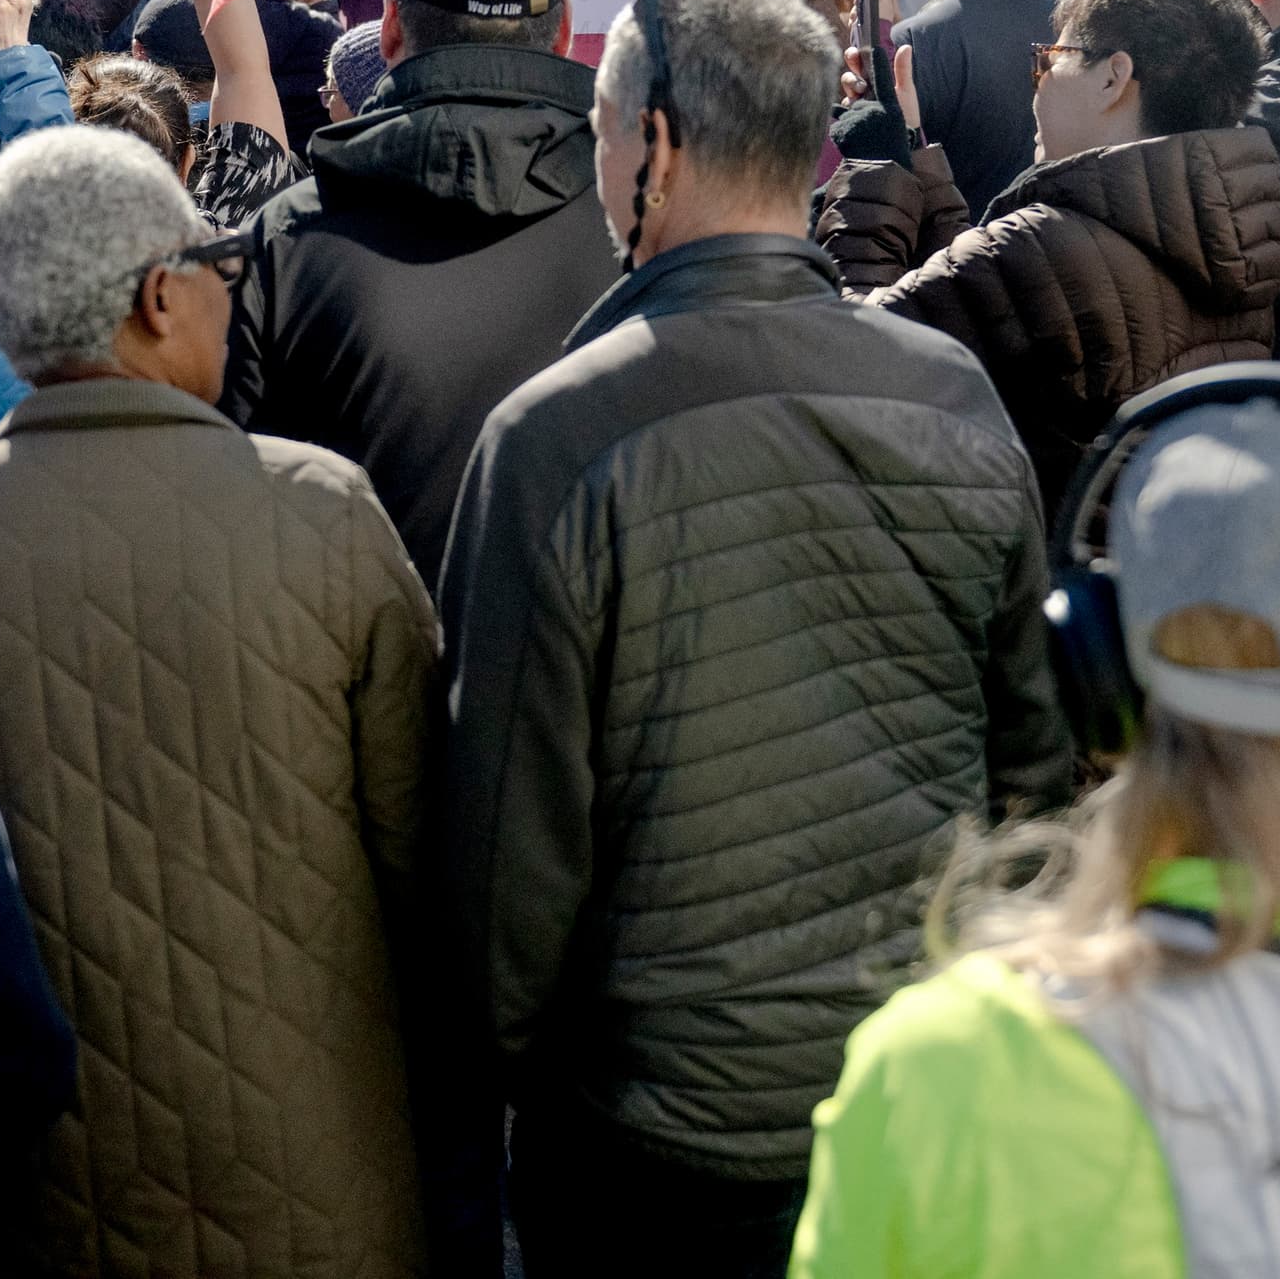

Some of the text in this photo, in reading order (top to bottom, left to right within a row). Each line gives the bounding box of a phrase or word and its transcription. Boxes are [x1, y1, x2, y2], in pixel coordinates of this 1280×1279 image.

[468, 0, 522, 16] Way of Life
